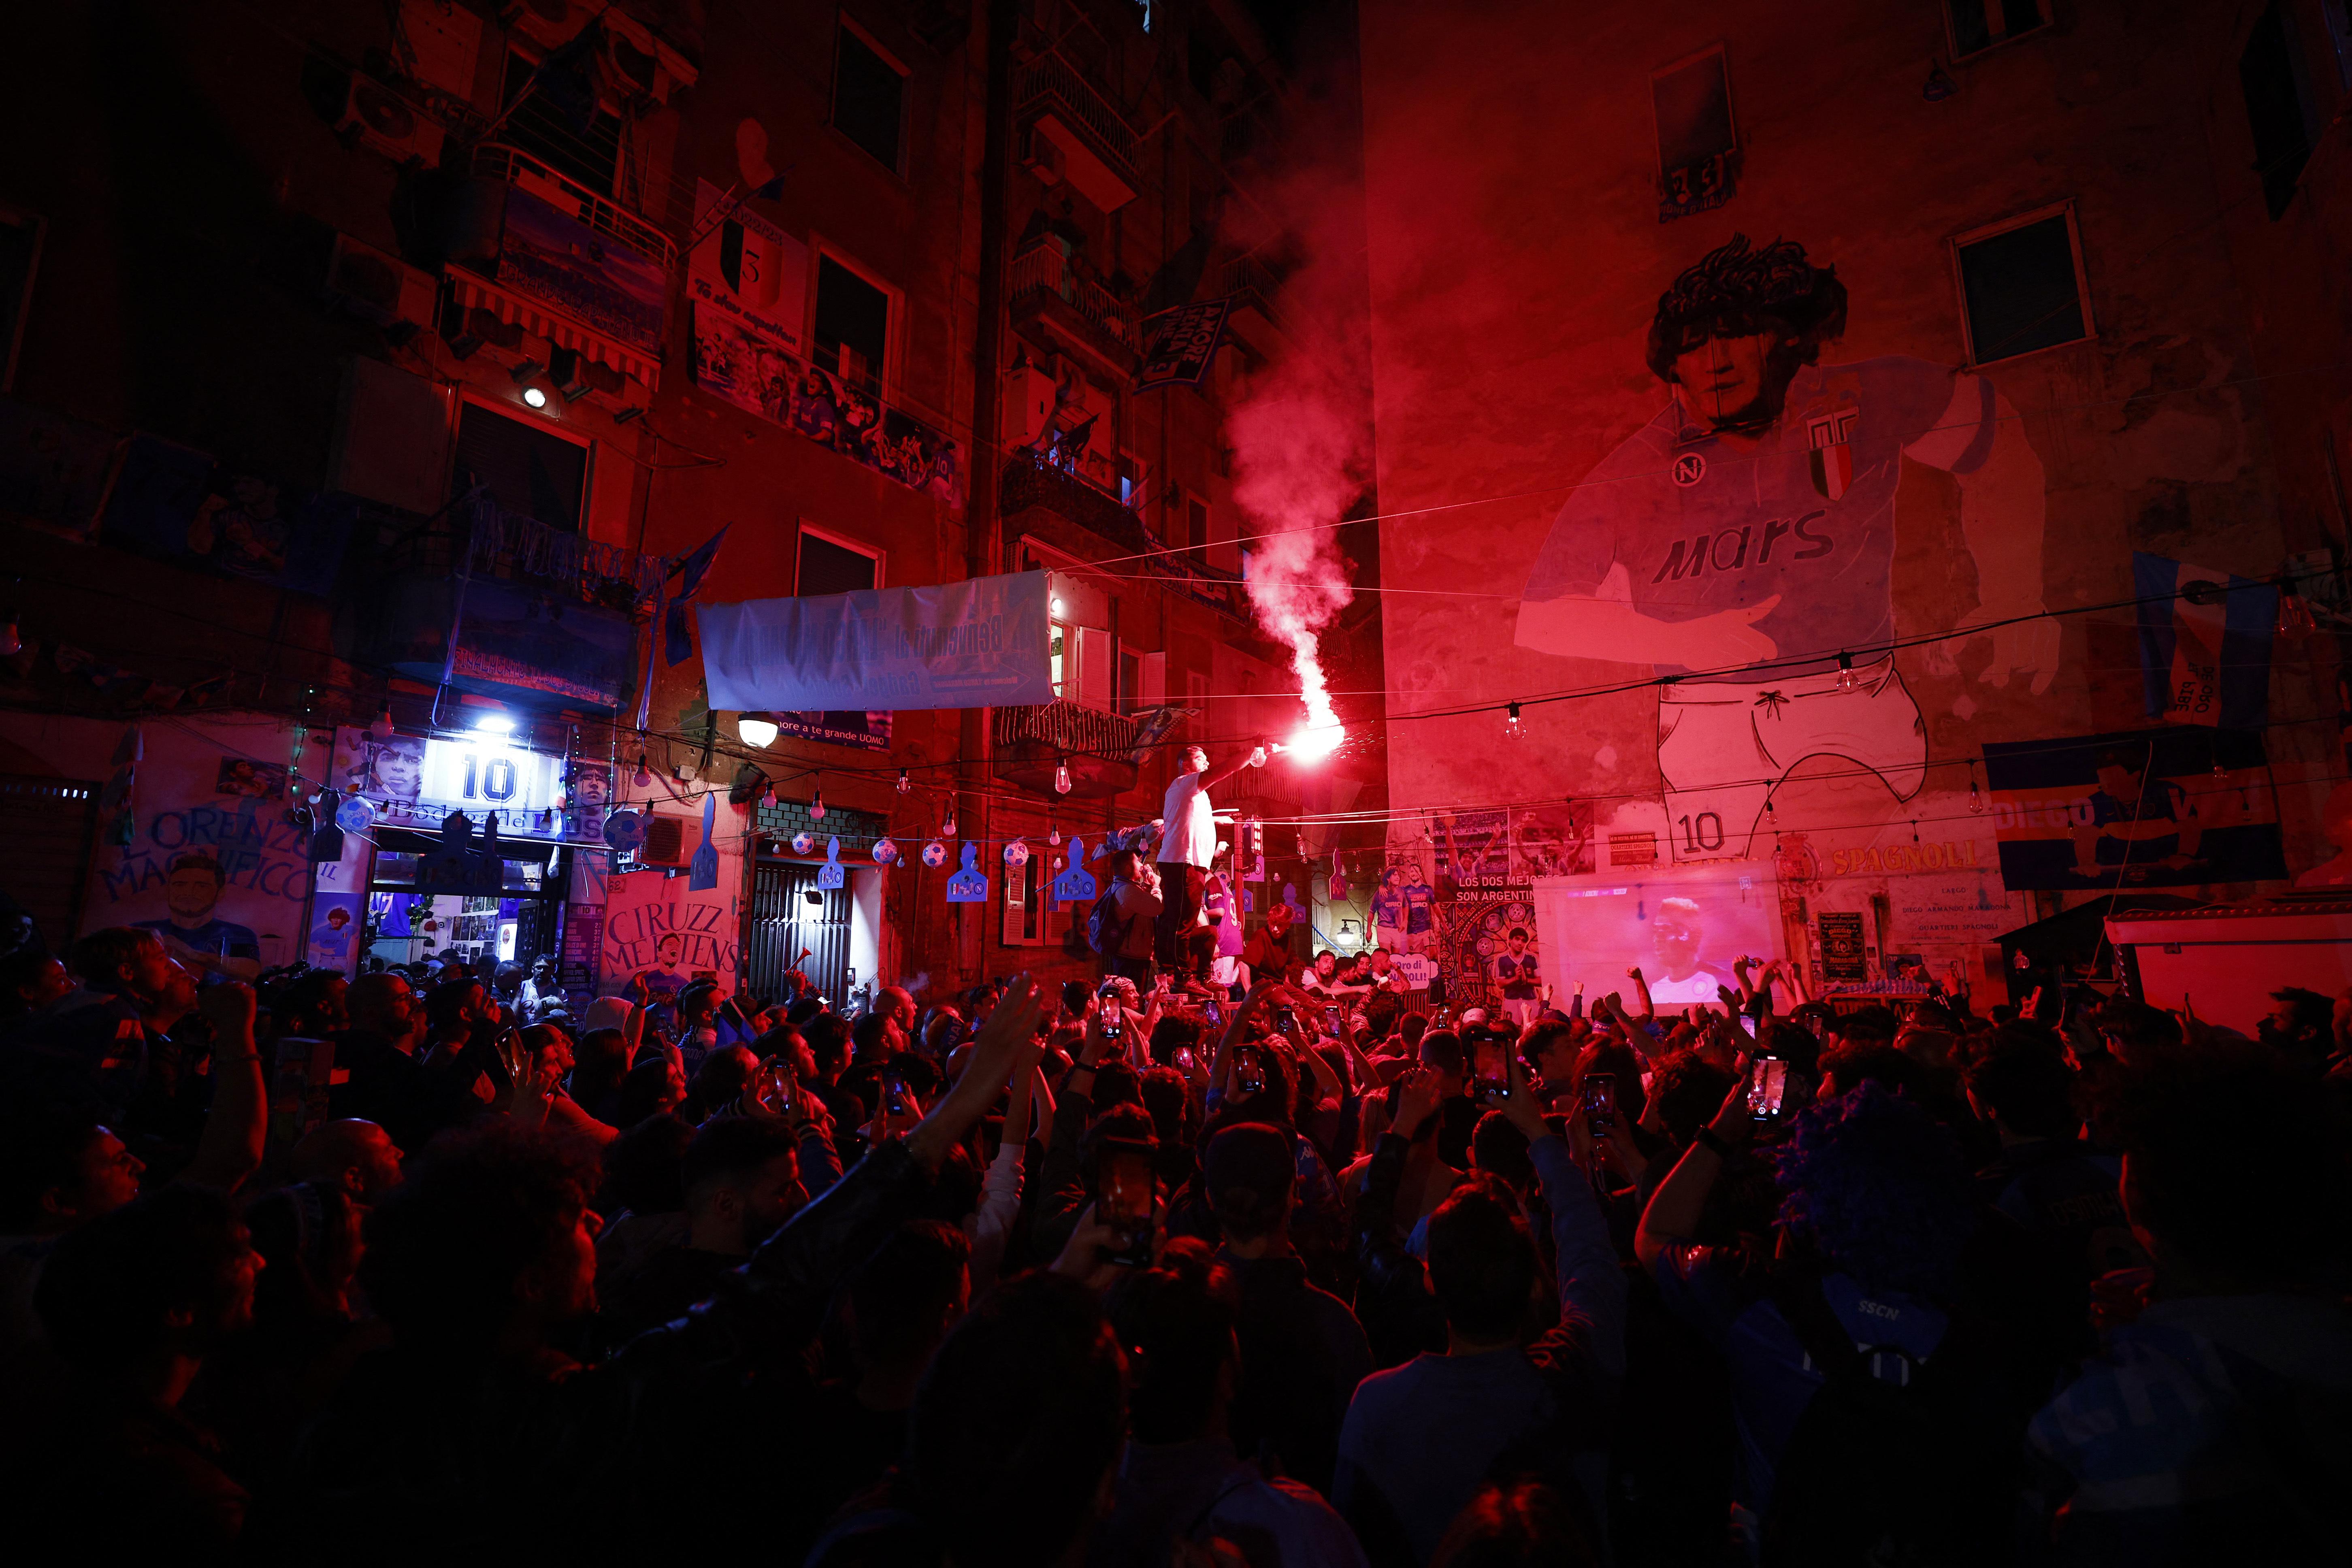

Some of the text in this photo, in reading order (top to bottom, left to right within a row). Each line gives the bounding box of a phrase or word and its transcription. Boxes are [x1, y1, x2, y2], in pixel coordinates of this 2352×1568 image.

[742, 249, 760, 283] 3
[1182, 306, 1222, 363] AMORE
[936, 456, 947, 475] 10
[1651, 509, 1834, 584] Mars
[454, 649, 526, 678] FINALMENTE
[812, 726, 822, 734] te
[825, 730, 857, 740] grande
[859, 733, 884, 746] UOMO
[462, 753, 518, 803] 10
[388, 800, 489, 829] Bodga
[498, 811, 523, 828] de
[1993, 797, 2096, 830] DIEGO
[1678, 812, 1724, 854] 10
[1832, 839, 1979, 876] SPAGNOLI
[609, 880, 621, 891] 62
[1457, 891, 1478, 901] SON
[1459, 877, 1479, 887] LOS
[1482, 876, 1503, 886] DOS
[608, 902, 723, 945] CIRUZZ
[1229, 897, 1238, 927] 9
[1413, 960, 1422, 969] di
[1858, 1299, 1900, 1321] SSCN
